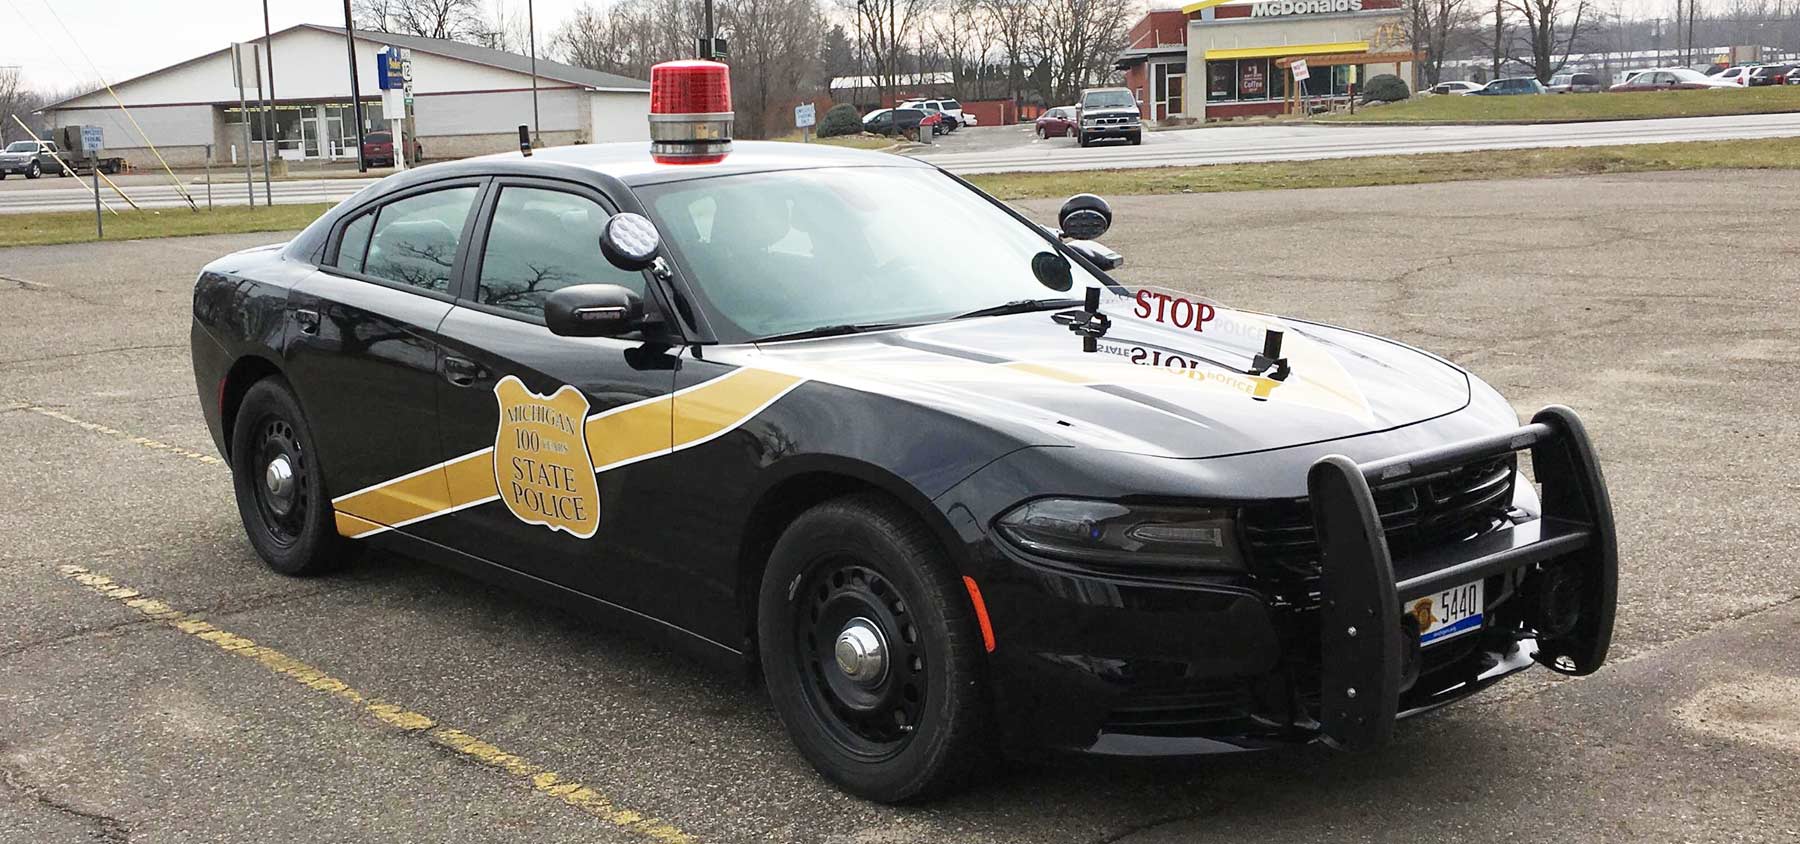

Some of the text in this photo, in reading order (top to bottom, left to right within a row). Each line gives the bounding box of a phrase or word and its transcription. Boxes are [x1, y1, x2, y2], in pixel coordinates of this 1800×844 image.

[1251, 0, 1362, 17] McDonald's
[1134, 288, 1216, 333] STOP
[507, 404, 576, 435] MICHIGAN
[515, 428, 540, 452] 100
[512, 456, 576, 493] STATE
[512, 481, 587, 521] POLICE
[1441, 584, 1477, 624] 5440
